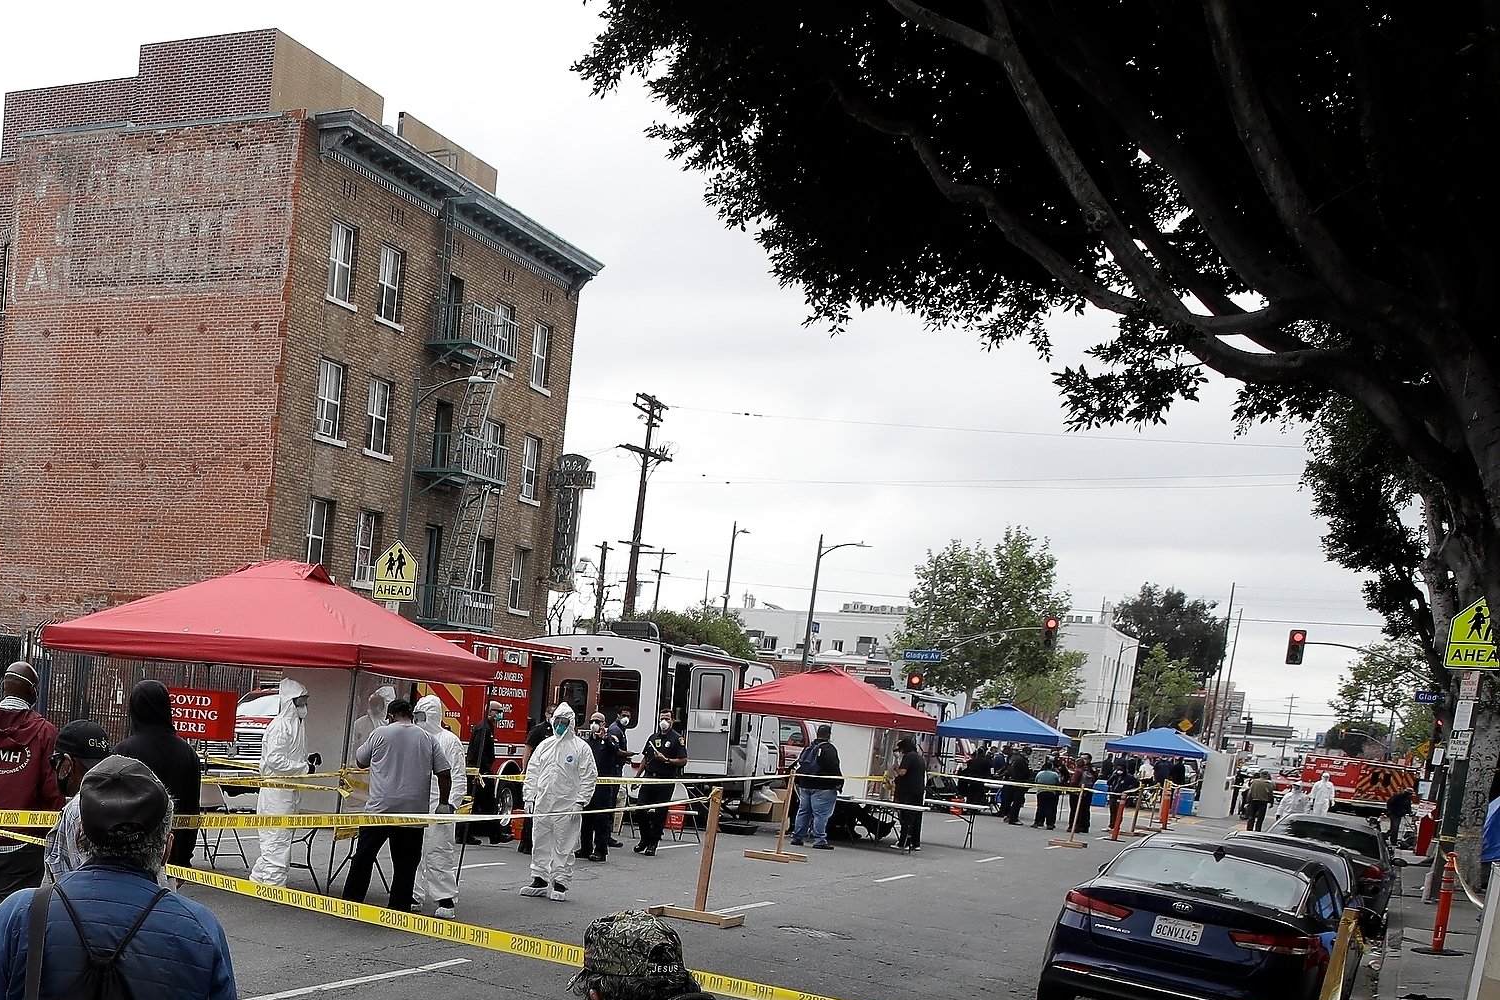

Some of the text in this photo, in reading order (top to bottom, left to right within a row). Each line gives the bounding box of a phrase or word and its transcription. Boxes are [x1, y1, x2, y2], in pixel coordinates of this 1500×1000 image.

[376, 585, 412, 596] AHEAD
[906, 652, 929, 660] Gladys
[1451, 649, 1498, 662] AHEA
[169, 694, 211, 707] COVID
[171, 708, 218, 721] ESTING
[1155, 923, 1199, 942] 8CNV145
[651, 963, 679, 974] JESUS
